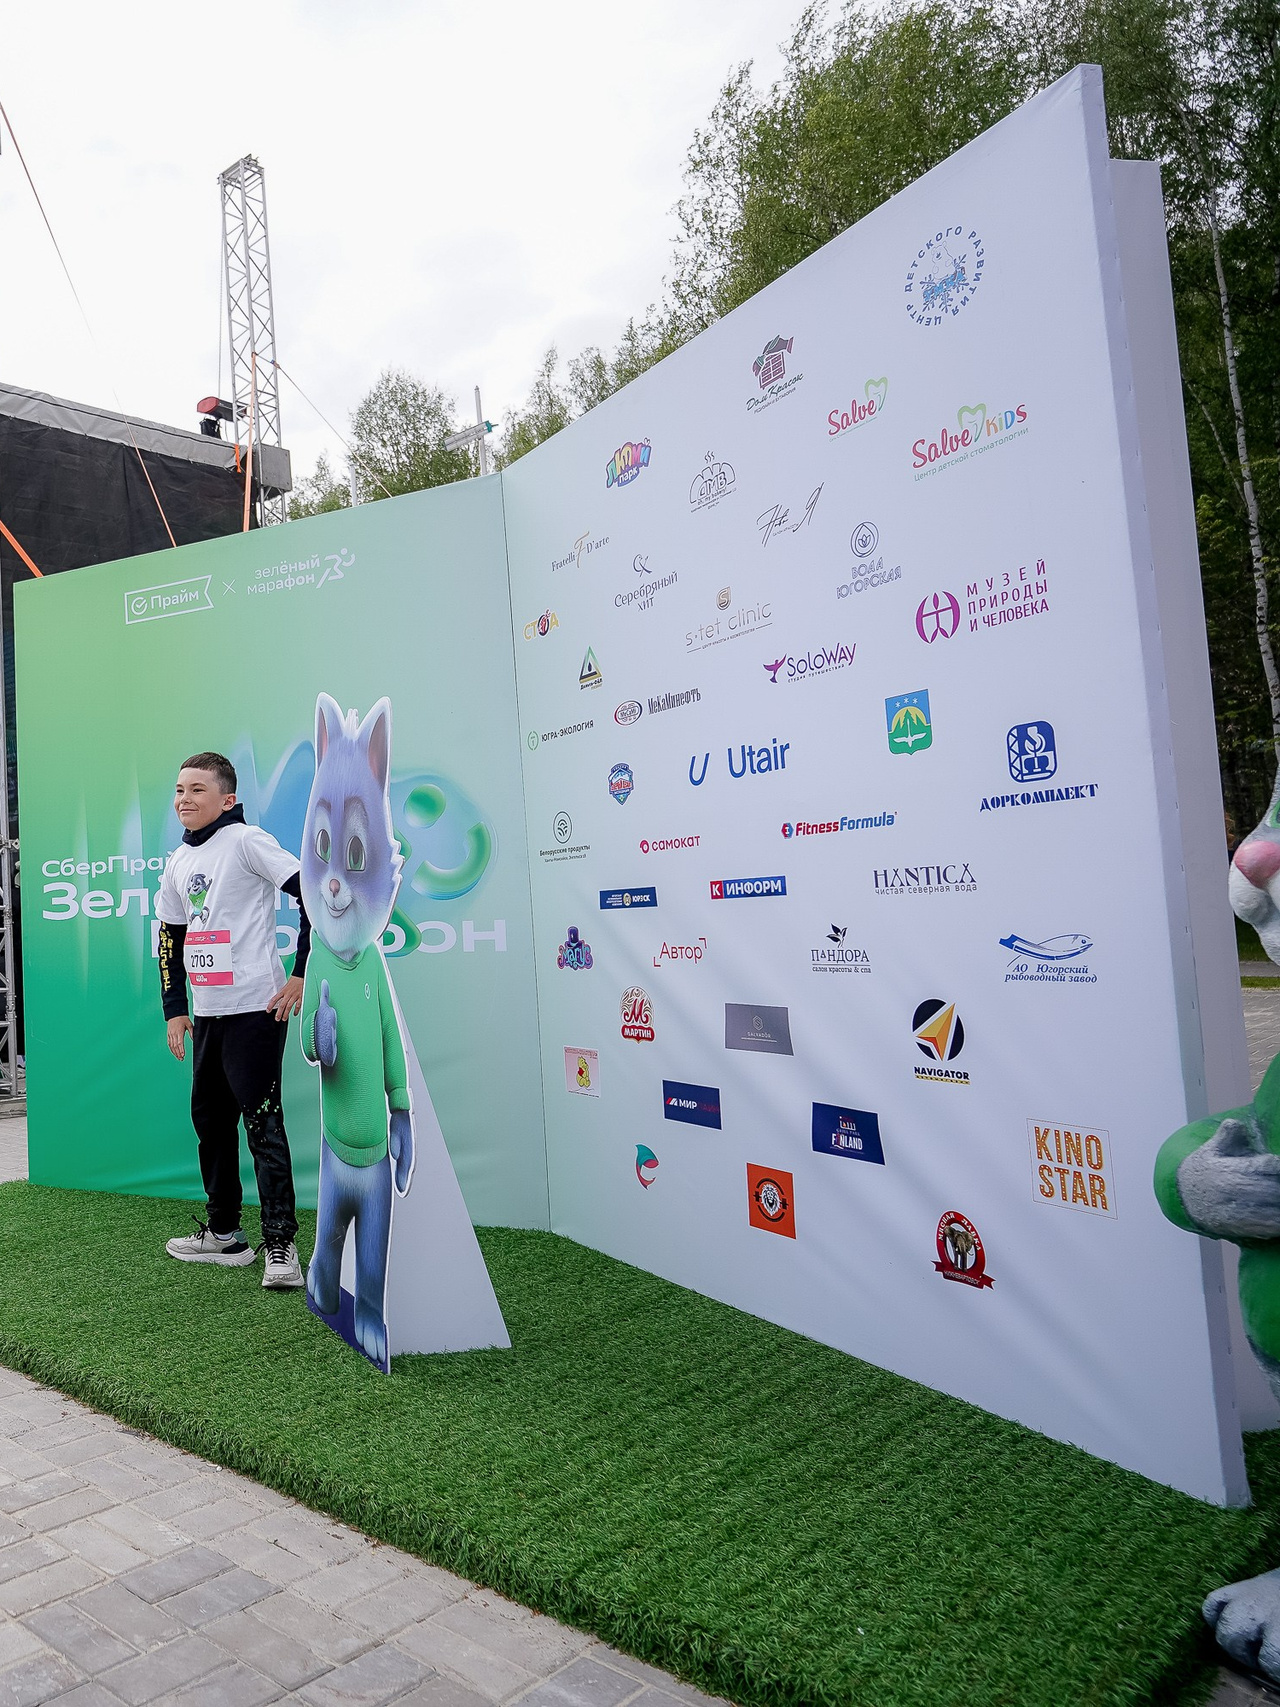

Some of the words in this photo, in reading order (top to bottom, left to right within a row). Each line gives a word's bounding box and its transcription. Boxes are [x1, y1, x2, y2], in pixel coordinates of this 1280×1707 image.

[904, 225, 963, 293] ДЕТСКОГО
[951, 230, 985, 316] РАЗВИТИЯ
[906, 304, 942, 326] ЦЕНТР
[828, 399, 877, 436] Salve
[912, 428, 973, 469] Salve
[914, 468, 937, 482] Центр
[938, 453, 969, 472] детской
[970, 427, 1029, 458] стоматологии
[254, 554, 321, 580] зелёный
[551, 551, 576, 572] Fratelli
[851, 556, 884, 580] ВОДА
[247, 572, 315, 596] марафон
[836, 565, 902, 600] ЮГОРСКАЯ
[966, 558, 1047, 598] МУЗЕЙ
[150, 588, 200, 610] Прайм
[968, 579, 1048, 615] ПРИРОДЫ
[728, 602, 772, 631] clinic
[970, 618, 978, 632] И
[982, 598, 1050, 628] ЧЕЛОВЕКА
[727, 737, 790, 779] Utair
[979, 783, 1099, 813] ДОРКОМПЛЕКТ
[651, 835, 700, 852] самокат
[41, 850, 172, 878] СберПра
[873, 863, 977, 888] HANTICA
[712, 883, 721, 896] К
[726, 880, 782, 896] ИНФОРМ
[875, 887, 904, 896] чистая
[907, 885, 951, 895] северная
[955, 883, 978, 893] вода
[190, 954, 214, 968] 2703
[659, 941, 703, 964] Автор
[810, 949, 870, 963] ПАНДОРА
[1004, 972, 1066, 982] рыбоводный
[1068, 974, 1098, 983] завод
[1012, 963, 1029, 973] АО
[1036, 963, 1089, 975] Югорский
[623, 1027, 652, 1039] МАРТИН
[914, 1066, 970, 1080] NAVIGATOR
[678, 1098, 698, 1110] МИР
[1033, 1126, 1104, 1171] KINO
[1037, 1164, 1109, 1211] STAR
[961, 1218, 982, 1251] ЛАВКА
